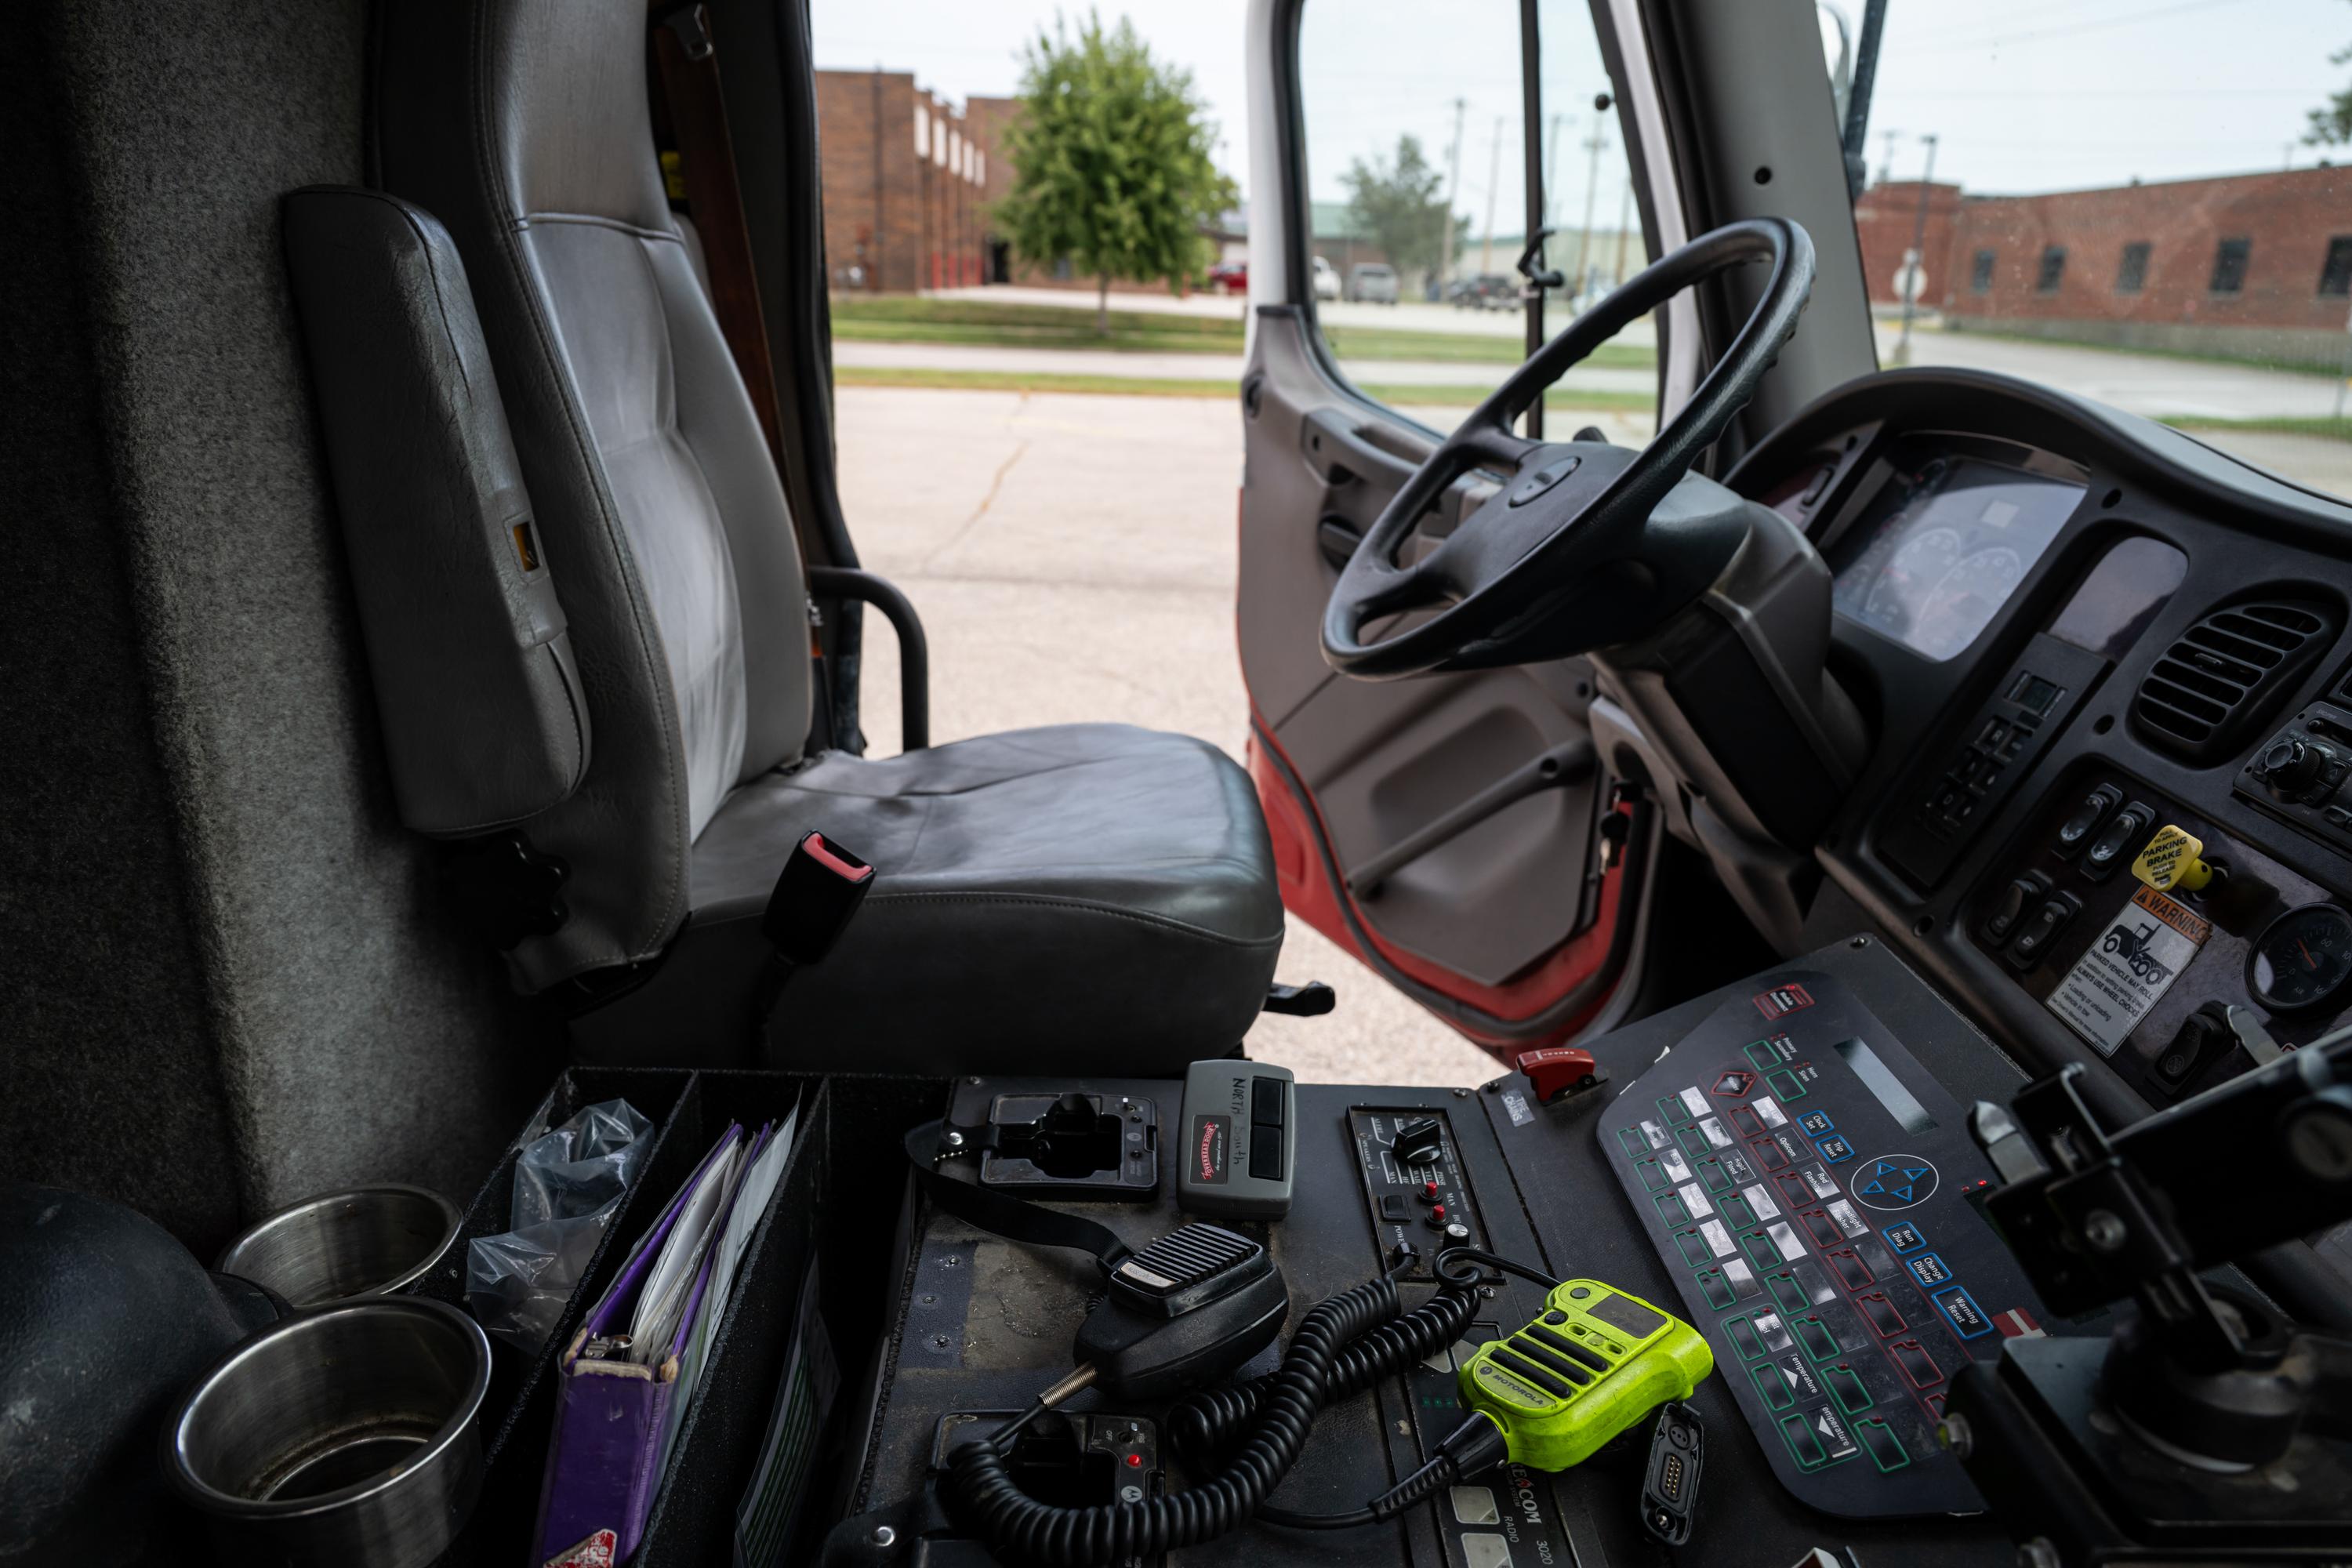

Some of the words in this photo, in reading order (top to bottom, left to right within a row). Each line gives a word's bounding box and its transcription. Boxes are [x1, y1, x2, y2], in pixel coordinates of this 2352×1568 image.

[2143, 837, 2187, 858] PARKING
[2147, 848, 2182, 867] BRAKE
[2149, 895, 2208, 940] WARNING
[2090, 949, 2110, 966] PARKED
[2108, 962, 2129, 981] VEHICLE
[2128, 977, 2142, 989] MAY
[2077, 967, 2095, 983] ALWAYS
[2092, 978, 2104, 989] USE
[2103, 985, 2119, 1003] WHEEL
[2118, 1000, 2140, 1018] CHOCKS
[2105, 976, 2120, 991] setting
[2117, 985, 2132, 1001] parking
[2063, 993, 2080, 1007] Vehicle
[2071, 985, 2087, 1003] Loading
[2090, 1000, 2111, 1022] unloading
[1774, 1040, 1792, 1061] Secondary
[1783, 1036, 1798, 1054] Primary
[1798, 1070, 1810, 1082] Siren
[1807, 1066, 1819, 1079] Horn
[1231, 1077, 1247, 1116] NORTH
[1806, 1120, 1816, 1130] Set
[1813, 1116, 1826, 1129] Clock
[1203, 1127, 1214, 1142] DOOR
[1233, 1125, 1247, 1165] South
[1362, 1140, 1371, 1163] SPEAKERS
[1780, 1137, 1796, 1157] Opticom
[1824, 1144, 1837, 1158] Reset
[1833, 1142, 1844, 1152] Trip
[1202, 1142, 1212, 1173] OVERHEAD
[1726, 1160, 1739, 1174] Flood
[1734, 1158, 1747, 1174] Right
[1388, 1171, 1397, 1184] MAN
[1413, 1170, 1421, 1185] WAIL
[1424, 1171, 1432, 1182] YEL
[1804, 1171, 1823, 1192] Flashing
[1817, 1172, 1829, 1184] Red
[1446, 1192, 1456, 1207] MAN
[1831, 1209, 1850, 1229] Flasher
[1839, 1203, 1863, 1229] Headlight
[1394, 1225, 1406, 1243] POWE
[1892, 1232, 1906, 1247] Diag
[1902, 1229, 1915, 1243] Run
[1913, 1261, 1934, 1283] Display
[1923, 1257, 1944, 1280] Change
[1947, 1305, 1965, 1323] Reset
[1955, 1296, 1979, 1324] Warning
[1493, 1374, 1543, 1405] MOTOROLA
[1821, 1404, 1849, 1446] emperature
[1510, 1465, 1542, 1524] ECOM
[1504, 1515, 1519, 1543] RADIO
[1537, 1540, 1553, 1565] 3020
